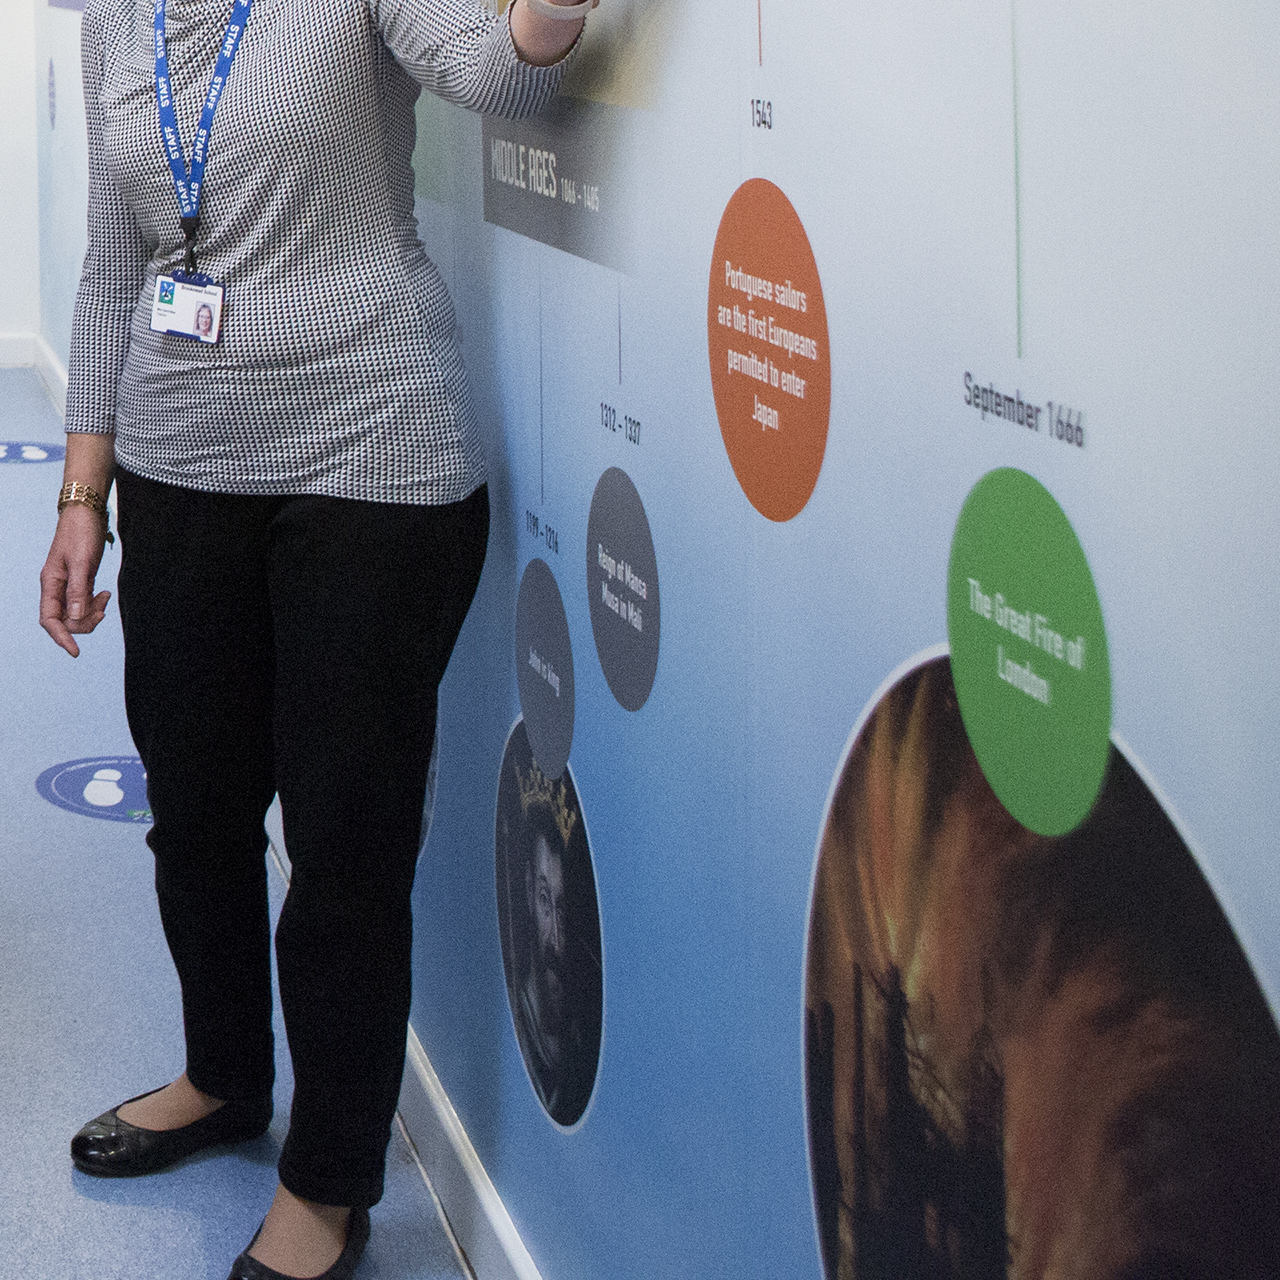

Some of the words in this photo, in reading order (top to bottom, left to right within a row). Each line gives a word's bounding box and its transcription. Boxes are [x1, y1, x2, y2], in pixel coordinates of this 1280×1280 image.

[156, 30, 164, 59] STAFF
[222, 24, 240, 58] STAFF
[158, 77, 170, 108] STAFF
[207, 76, 222, 110] STAFF
[751, 99, 772, 130] 1543
[164, 126, 179, 160] STAFF
[194, 128, 207, 163] STAFF
[491, 138, 526, 189] MIDDLE
[528, 147, 557, 198] AGES
[561, 177, 576, 204] 1066
[583, 184, 599, 212] 1485
[176, 180, 191, 213] STAFF
[203, 289, 218, 297] School
[725, 260, 773, 301] Portuguese
[775, 279, 807, 313] sailors
[718, 305, 731, 328] are
[733, 305, 746, 333] the
[748, 309, 767, 341] first
[768, 316, 817, 360] Europeans
[728, 349, 768, 383] permitted
[770, 361, 779, 388] to
[781, 370, 805, 399] enter
[600, 402, 616, 432] 1312
[624, 415, 641, 446] 1337
[752, 394, 779, 431] Japan
[964, 371, 1041, 432] September
[1047, 401, 1084, 448] 1666
[597, 543, 616, 579] Reign
[617, 560, 624, 582] of
[625, 562, 648, 600] Mansa
[602, 581, 619, 614] Musa
[620, 594, 627, 620] in
[628, 600, 643, 632] Mali
[967, 577, 992, 619] The
[995, 592, 1031, 642] Great
[1035, 614, 1063, 659] Fire
[1067, 635, 1085, 670] of
[998, 644, 1050, 705] London
